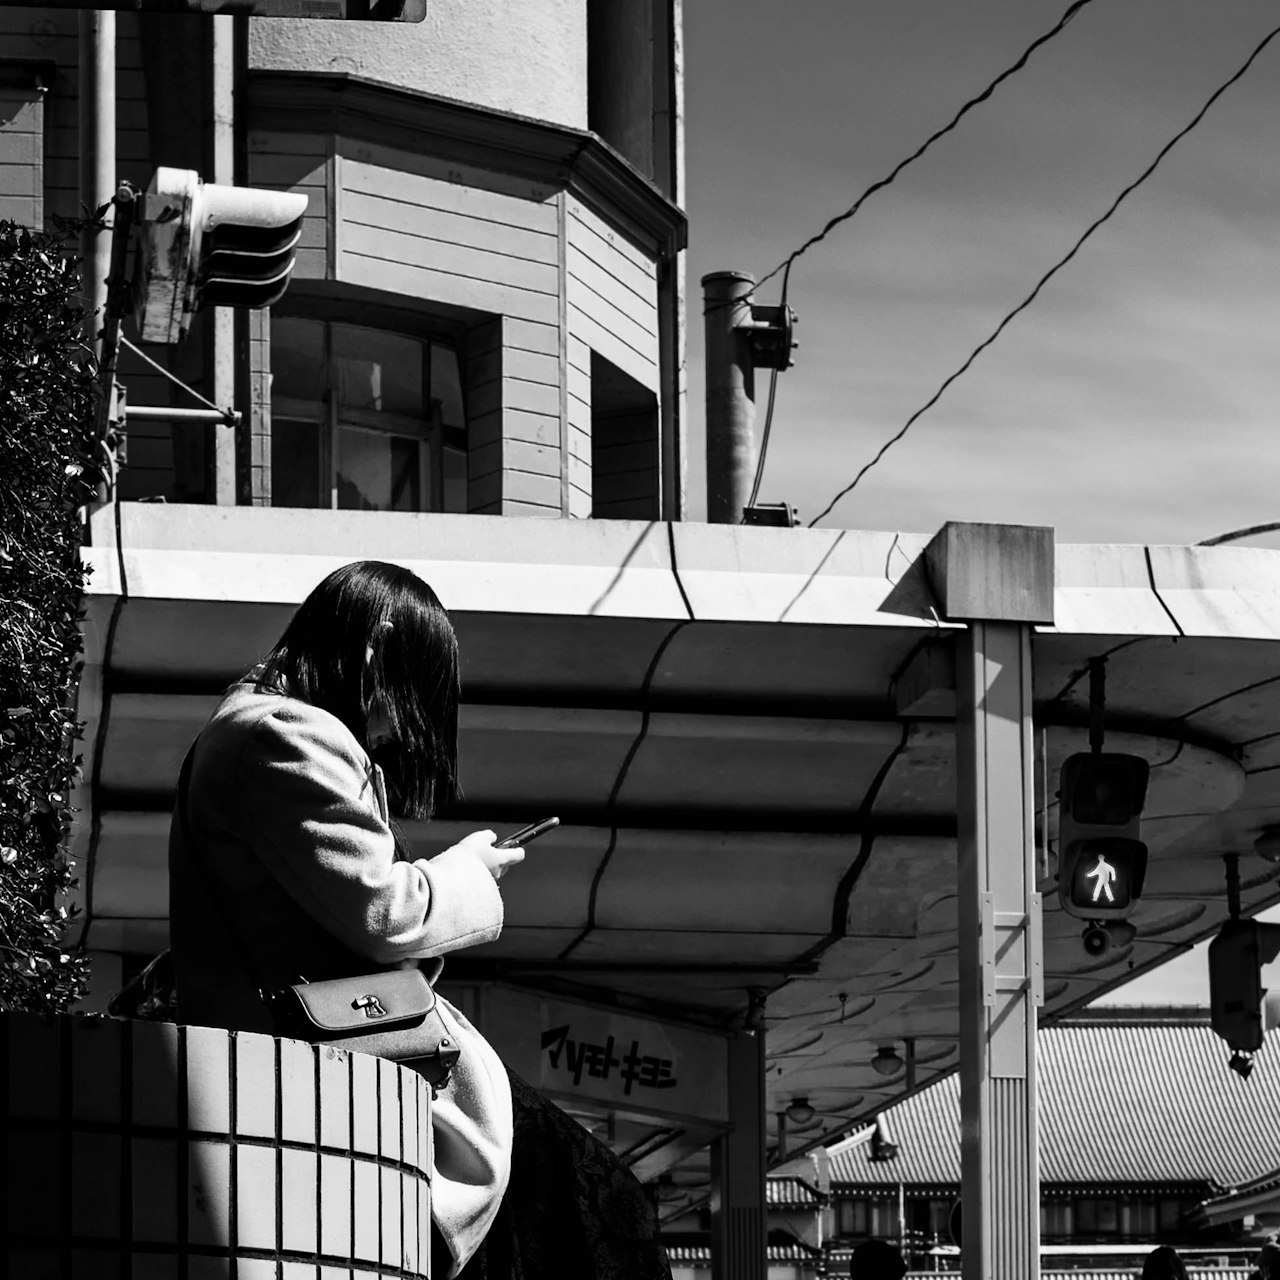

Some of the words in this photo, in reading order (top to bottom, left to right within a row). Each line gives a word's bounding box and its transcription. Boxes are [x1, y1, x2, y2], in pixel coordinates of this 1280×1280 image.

[541, 1024, 677, 1095] マツモトキヨシ
